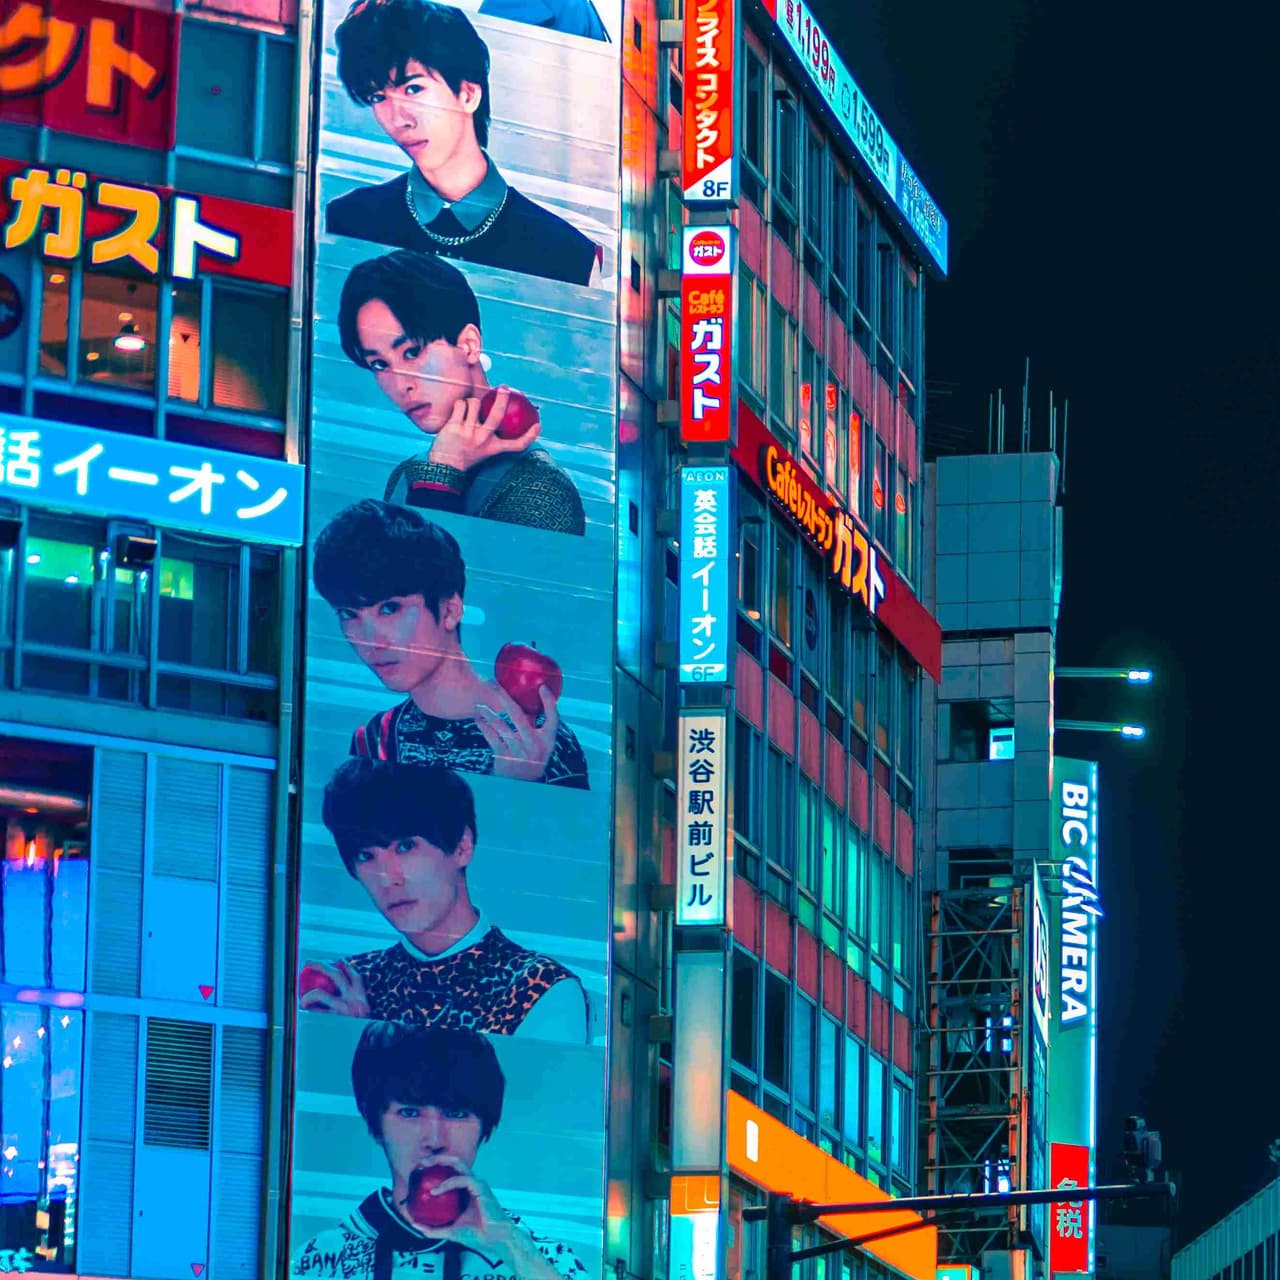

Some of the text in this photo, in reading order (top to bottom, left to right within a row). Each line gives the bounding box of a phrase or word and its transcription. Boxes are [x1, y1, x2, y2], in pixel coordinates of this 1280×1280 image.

[695, 0, 719, 169] ライスコンタクト
[702, 180, 729, 198] 8F
[6, 168, 241, 280] ガスト
[692, 245, 722, 258] ガスト
[688, 289, 725, 306] Café
[690, 317, 723, 422] ガスト
[685, 470, 726, 483] AEON
[765, 444, 798, 500] Café
[833, 510, 887, 617] ガスト
[691, 665, 715, 683] 6F
[687, 727, 716, 908] 渋谷駅前ビル
[1062, 781, 1088, 847] BIC
